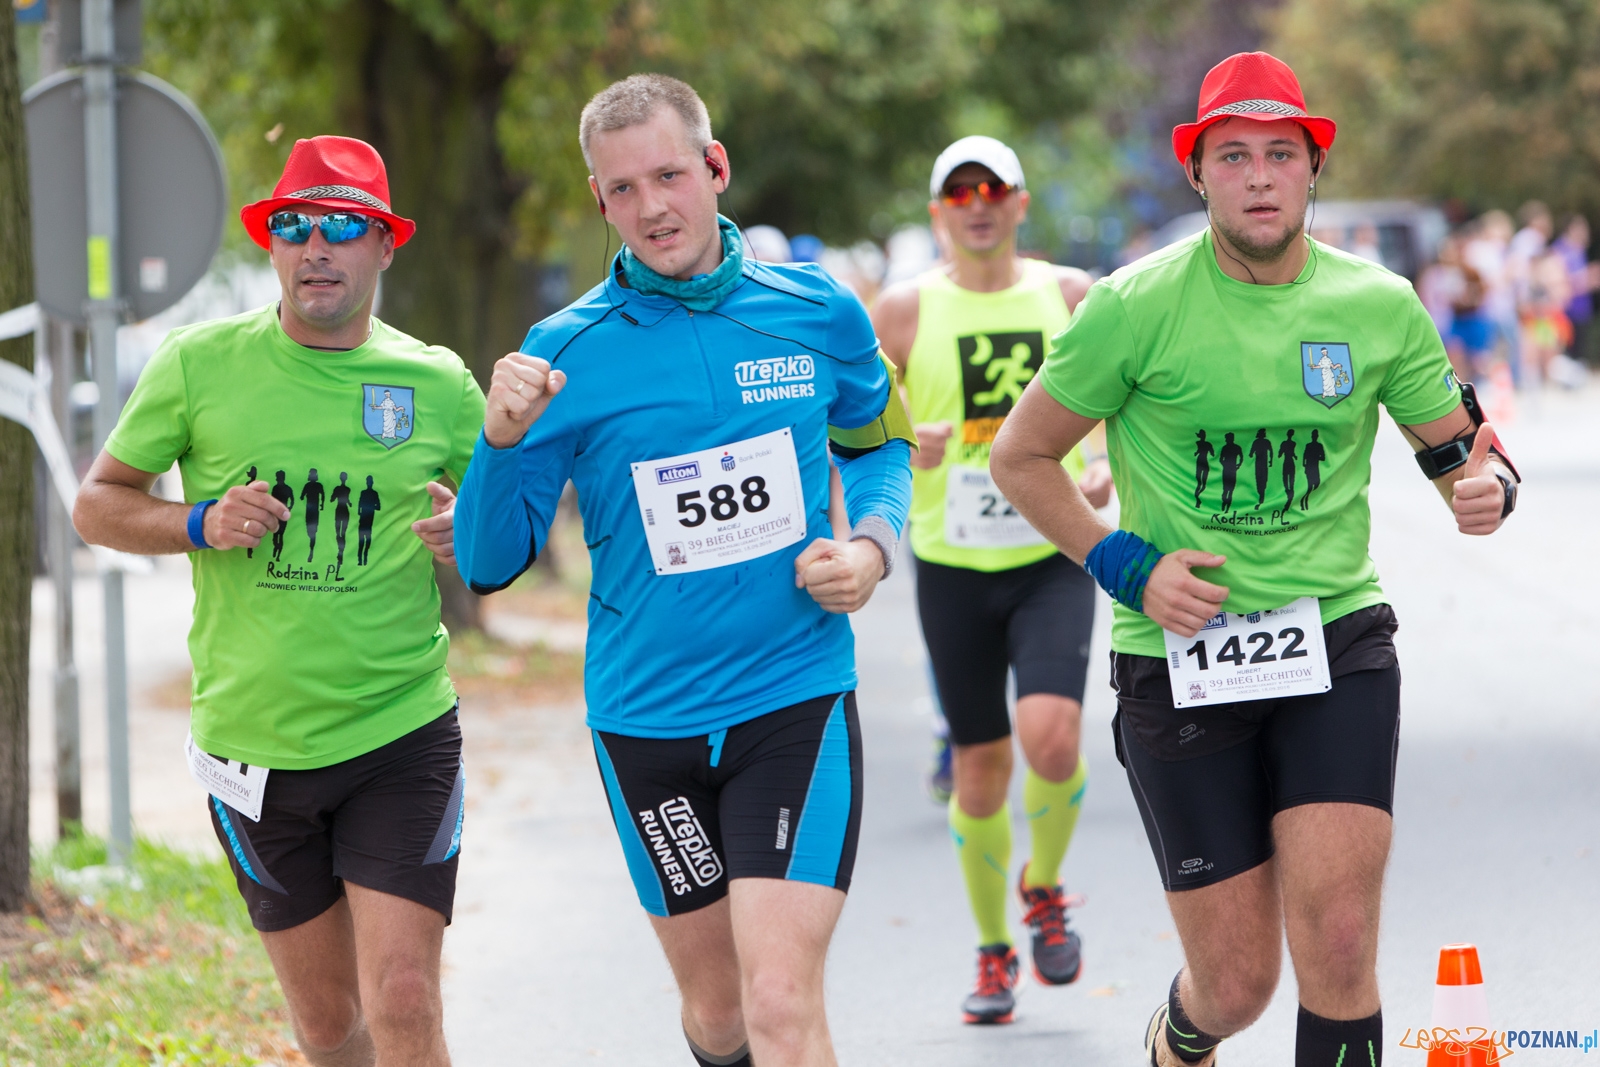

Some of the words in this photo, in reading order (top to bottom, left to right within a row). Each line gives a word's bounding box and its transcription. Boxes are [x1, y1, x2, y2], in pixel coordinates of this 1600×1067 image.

[735, 356, 813, 383] Trepko
[741, 383, 815, 405] RUNNERS
[739, 454, 754, 463] Bank
[755, 448, 773, 458] Polski
[677, 475, 771, 528] 588
[717, 522, 742, 533] MACIEJ
[1271, 510, 1290, 525] PL
[688, 540, 703, 551] 39
[706, 531, 735, 548] BIEG
[737, 513, 792, 540] LECHITÓW
[1201, 525, 1242, 535] JANOWIEC
[1244, 525, 1299, 536] WIELKOPOLSKI
[267, 561, 319, 580] Rodzina
[325, 562, 345, 581] PL
[256, 581, 296, 591] JANOWIEC
[298, 584, 358, 593] WIELKOPOLSKI
[1280, 607, 1297, 615] Polski
[1186, 627, 1308, 671] 1422
[1209, 679, 1224, 688] 39
[1226, 675, 1254, 687] BIEG
[1256, 666, 1314, 682] LECHITÓW
[1236, 667, 1262, 675] HUBERT
[209, 767, 252, 798] LECHITÓW
[665, 796, 720, 883] Trepko
[639, 809, 692, 896] RUNNERS
[1177, 862, 1215, 876] Kalenji
